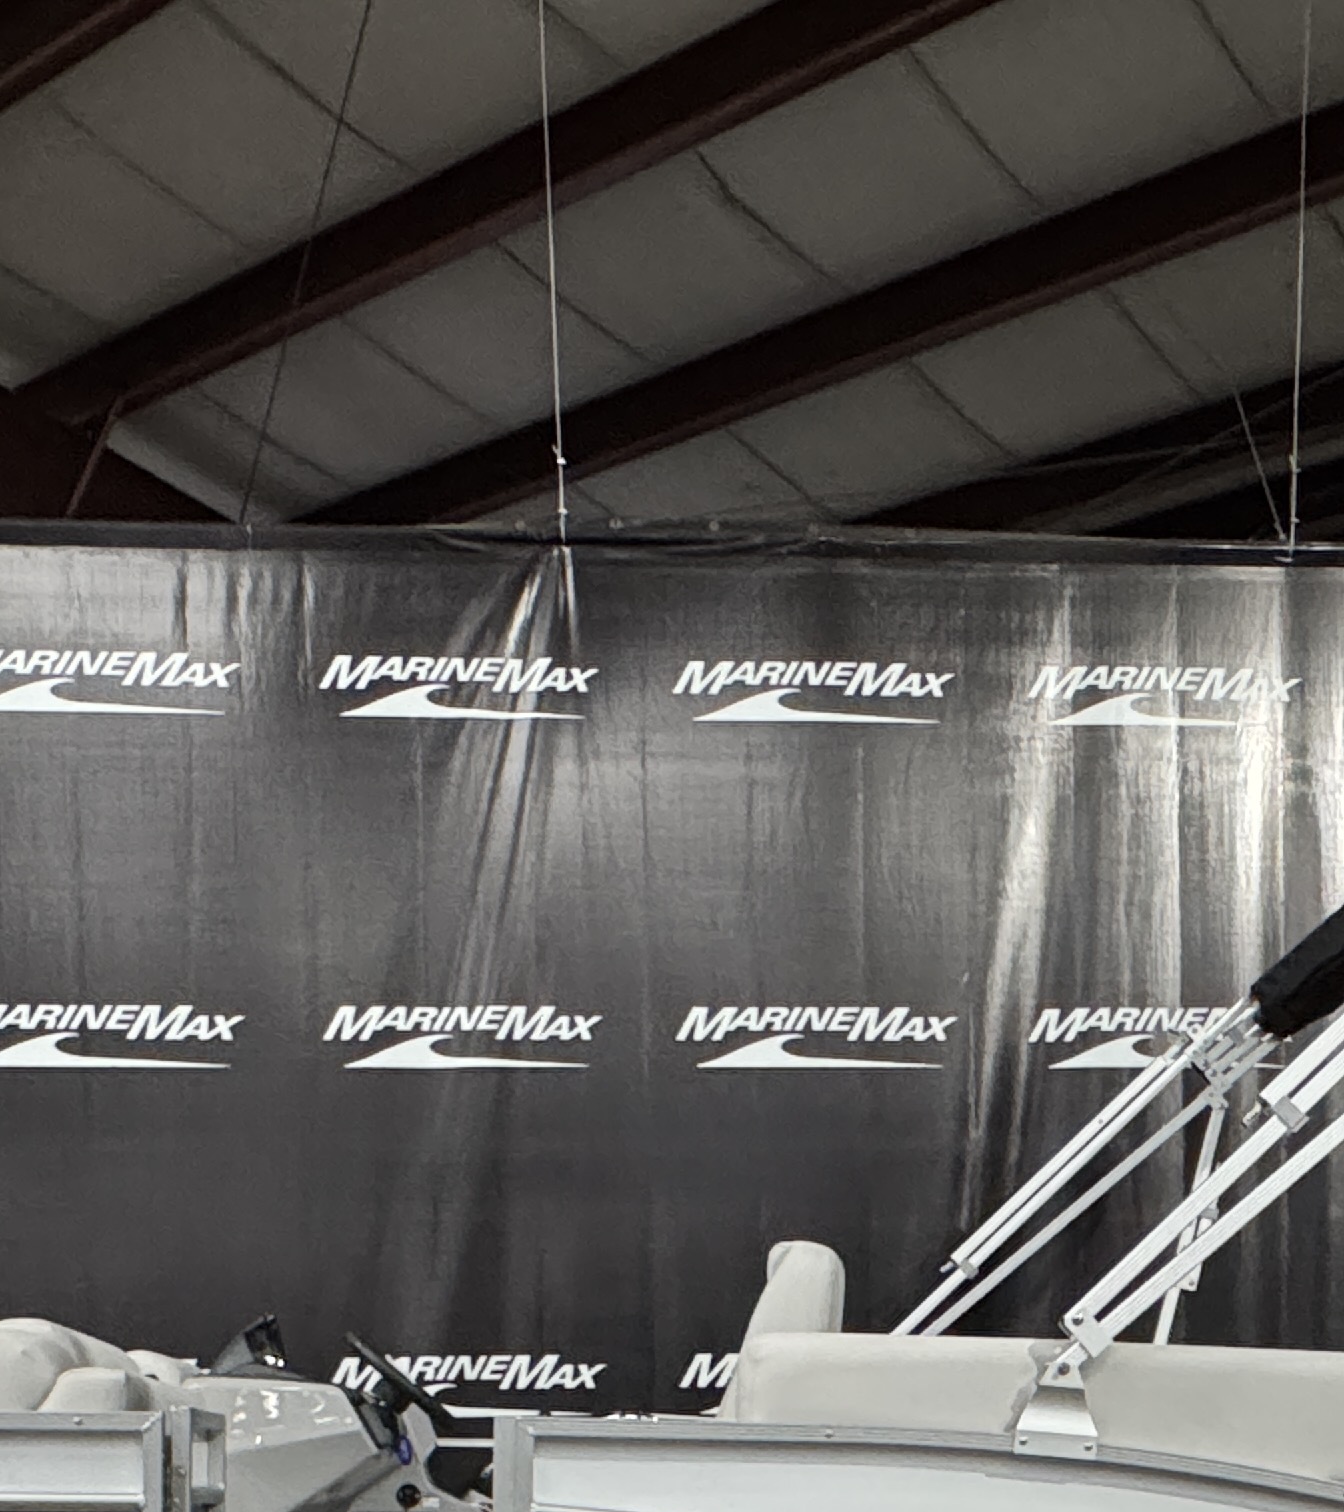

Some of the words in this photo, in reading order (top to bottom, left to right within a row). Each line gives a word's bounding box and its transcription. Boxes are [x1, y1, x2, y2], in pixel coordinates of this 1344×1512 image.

[319, 655, 599, 693] MARINEMAX
[672, 660, 956, 698] MARINEMAX
[323, 1005, 602, 1042] MARINEMAX
[675, 1006, 958, 1043] MARINEMAX
[1028, 1007, 1229, 1043] MARINE
